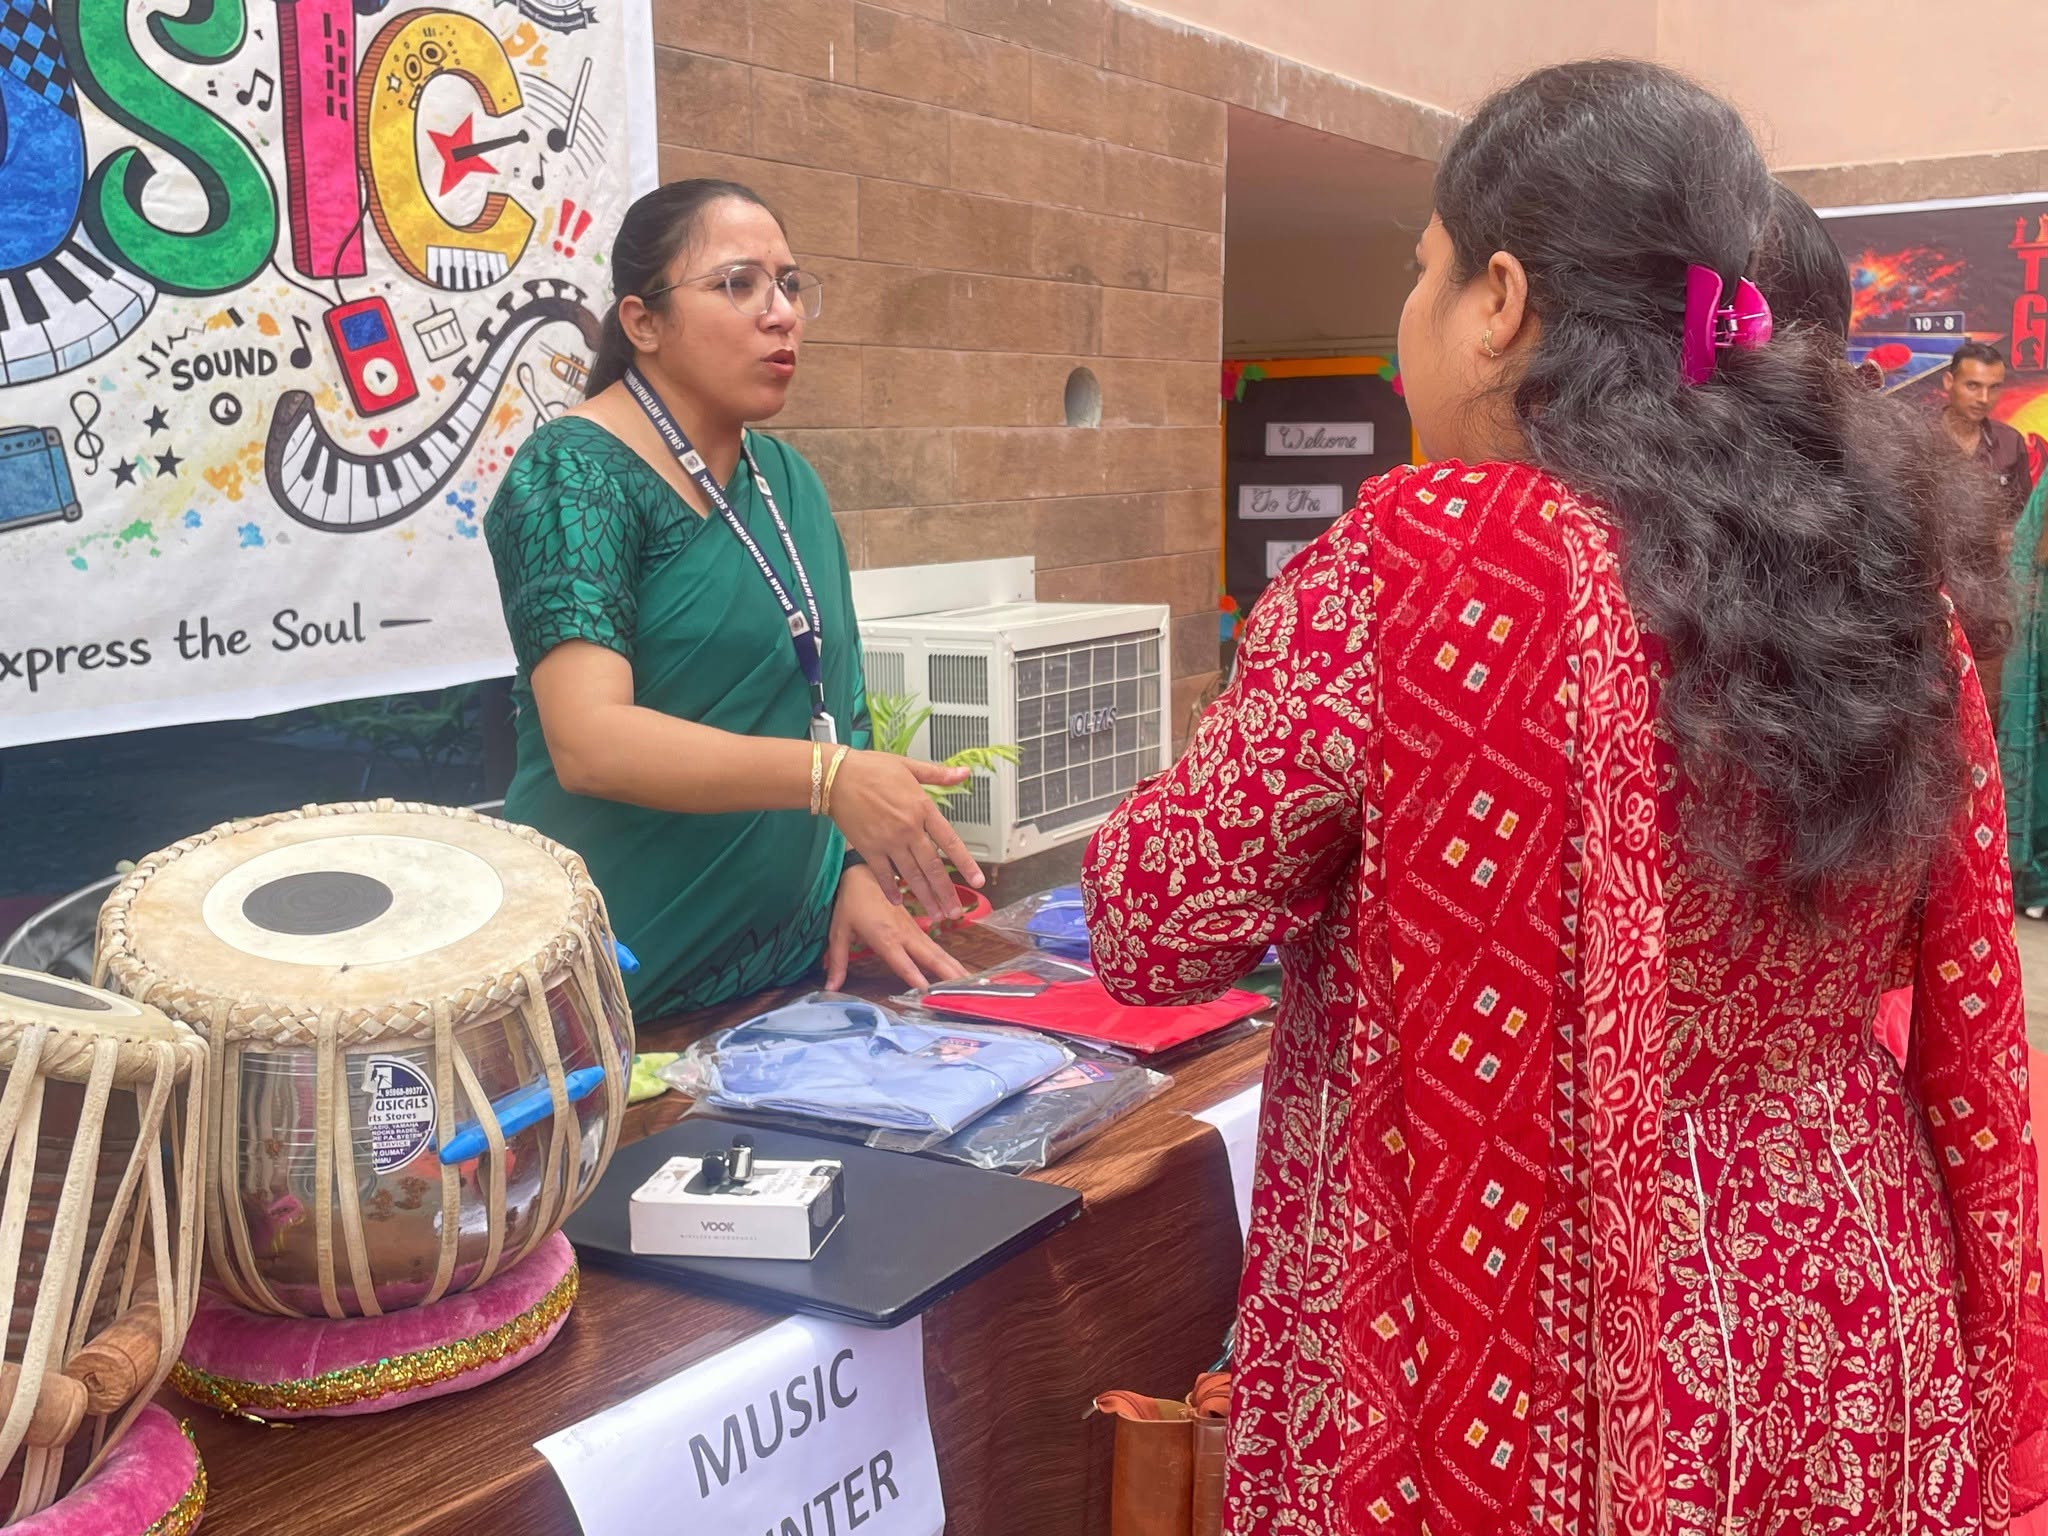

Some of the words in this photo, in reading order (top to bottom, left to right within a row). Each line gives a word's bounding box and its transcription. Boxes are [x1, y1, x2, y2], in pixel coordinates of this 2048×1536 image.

[1914, 317, 1932, 331] 10
[1944, 316, 1954, 331] 8
[170, 347, 278, 391] SOUND
[657, 417, 686, 450] SRIJAN
[1278, 425, 1357, 450] Welcome
[699, 474, 728, 510] SCHOOL
[1251, 487, 1280, 514] To
[1286, 487, 1321, 514] The
[725, 511, 775, 578] INTERNATIONAL
[782, 532, 814, 598] INTERNATIONAL
[769, 578, 794, 611] SRIJAN
[808, 598, 821, 633] SRIJAN
[0, 634, 152, 692] xpress
[174, 615, 251, 660] the
[271, 602, 366, 648] Soul
[385, 1112, 417, 1121] Stores
[700, 1220, 736, 1233] VOOK
[688, 1348, 859, 1499] MUSIC
[766, 1449, 900, 1536] NTER
